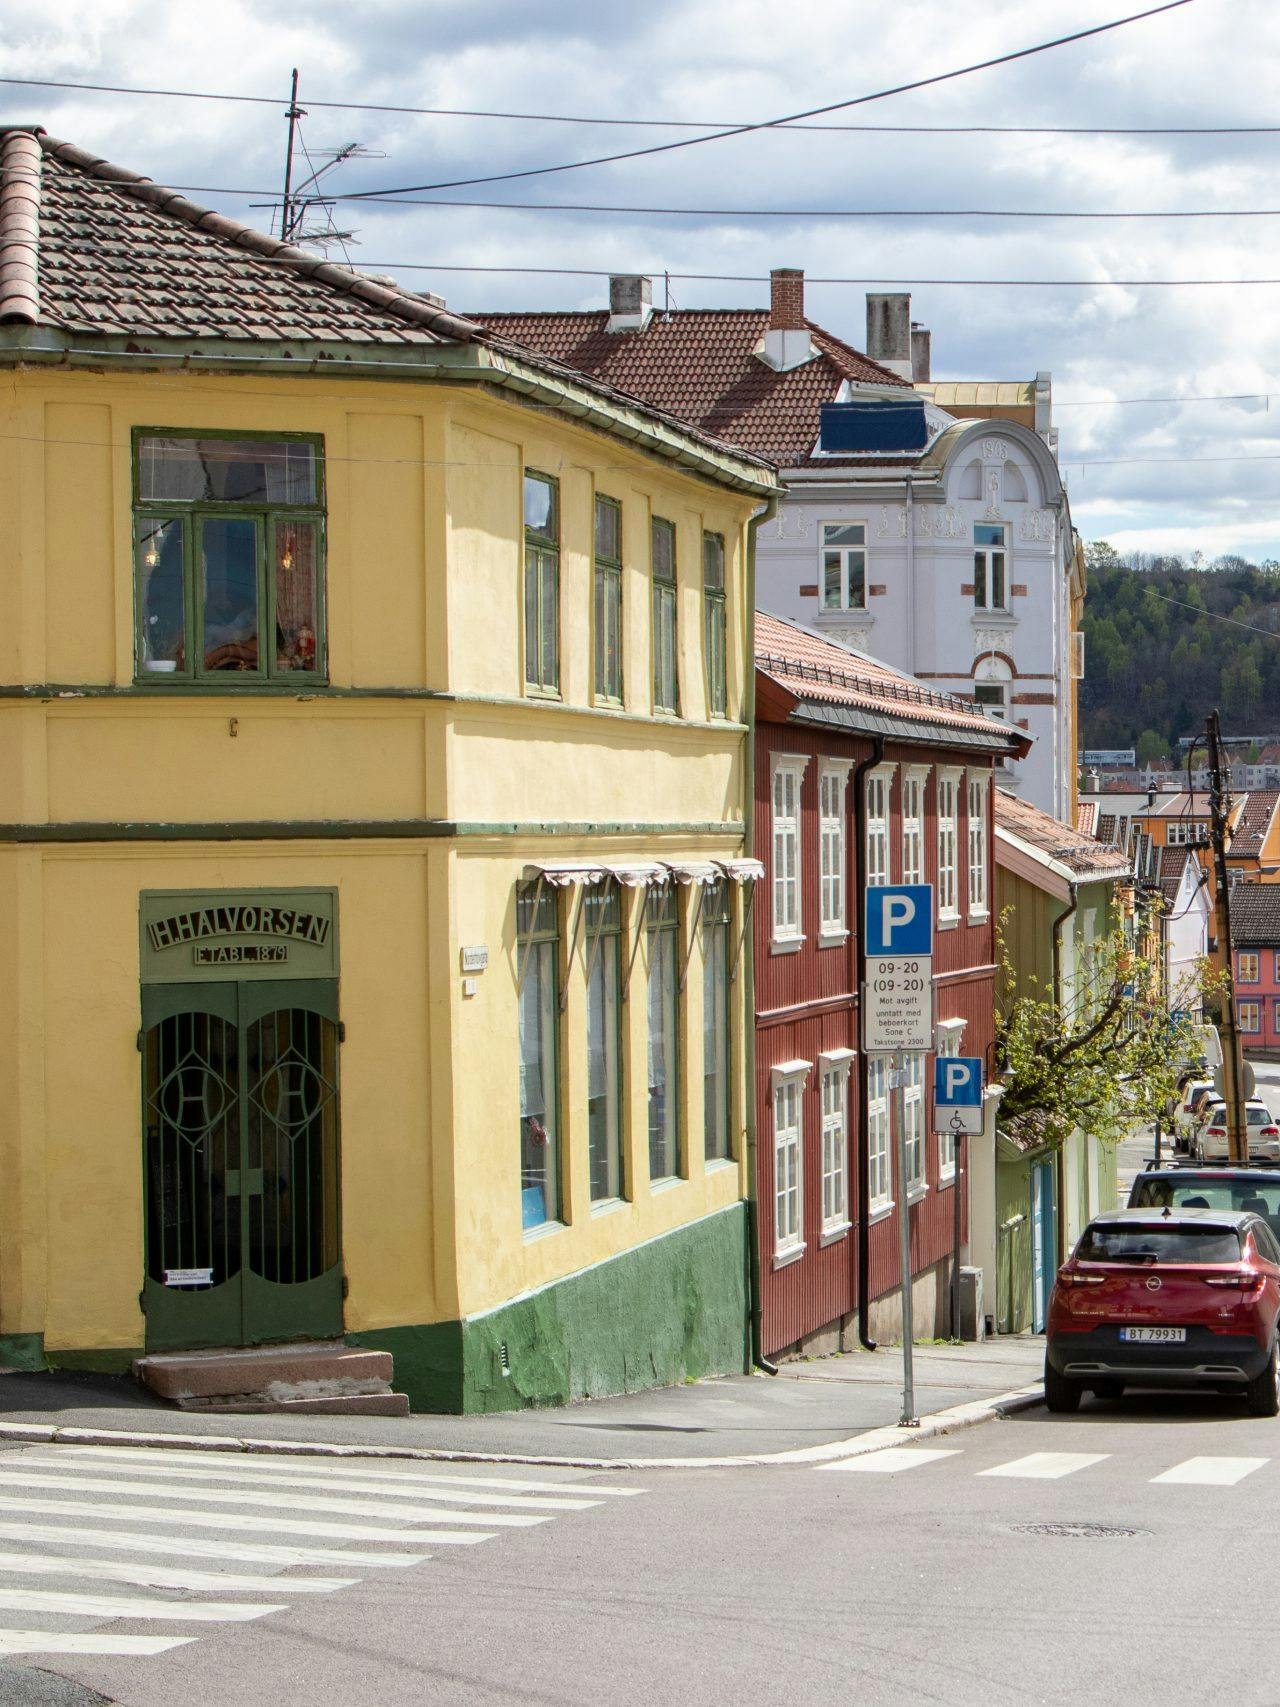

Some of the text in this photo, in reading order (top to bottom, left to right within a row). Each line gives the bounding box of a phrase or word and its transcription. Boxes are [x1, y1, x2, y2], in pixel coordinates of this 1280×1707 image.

[882, 894, 916, 947] P
[879, 997, 917, 1006] Mot avgift
[876, 1010, 902, 1018] unntatt
[878, 1019, 918, 1027] beboerkort
[885, 1028, 903, 1036] Sone
[946, 1063, 971, 1100] P
[1130, 1328, 1182, 1340] BT 79931
